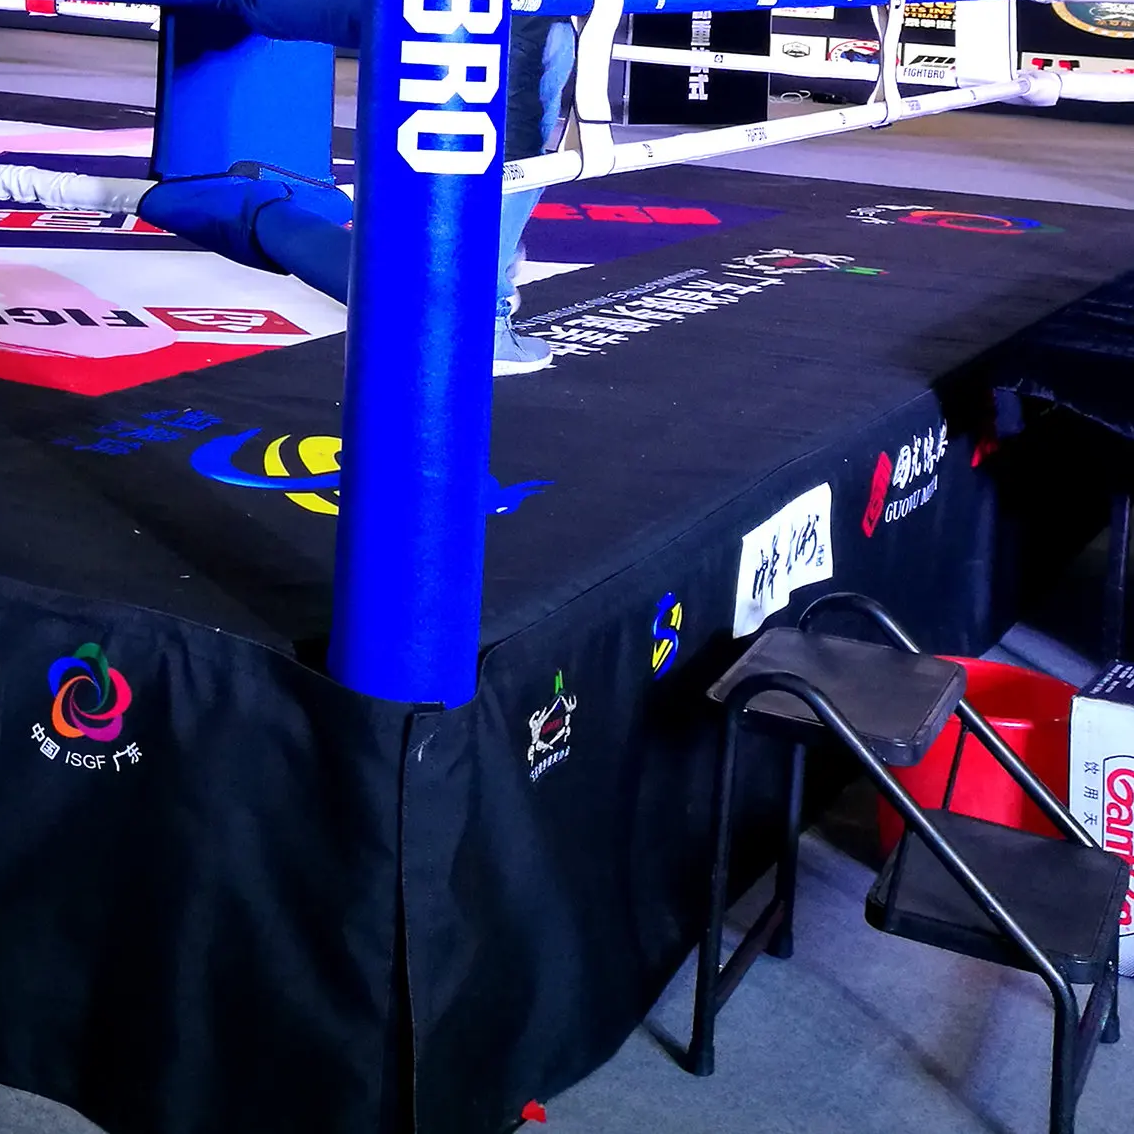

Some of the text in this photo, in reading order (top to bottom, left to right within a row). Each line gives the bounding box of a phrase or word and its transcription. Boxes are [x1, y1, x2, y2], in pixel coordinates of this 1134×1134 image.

[903, 67, 946, 80] FIGHTBRO
[29, 722, 61, 760] 中国
[65, 750, 106, 770] ISGF
[112, 741, 143, 771] 广东
